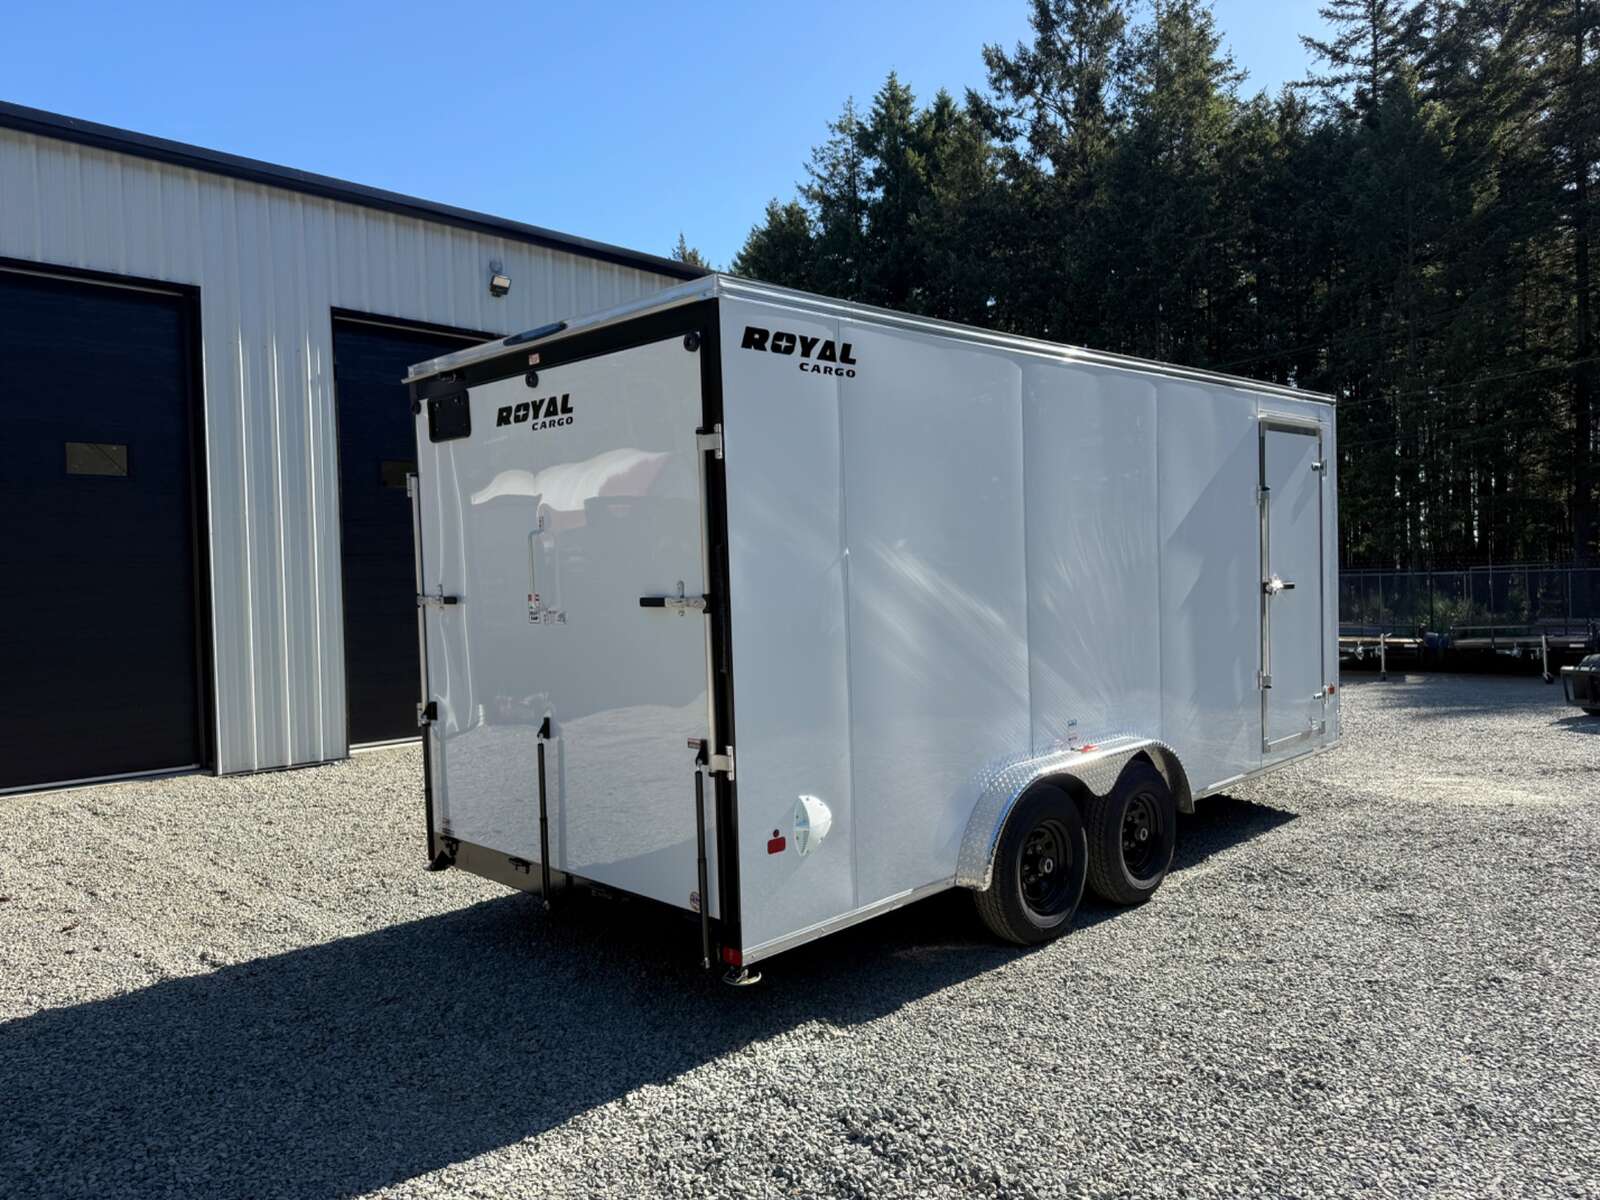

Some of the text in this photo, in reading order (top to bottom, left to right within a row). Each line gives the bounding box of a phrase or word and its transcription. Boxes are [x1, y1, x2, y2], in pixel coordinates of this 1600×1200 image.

[741, 326, 857, 365] ROYAL
[799, 362, 856, 378] CARGO
[496, 393, 574, 427] ROYAL
[531, 416, 574, 431] CARGO
